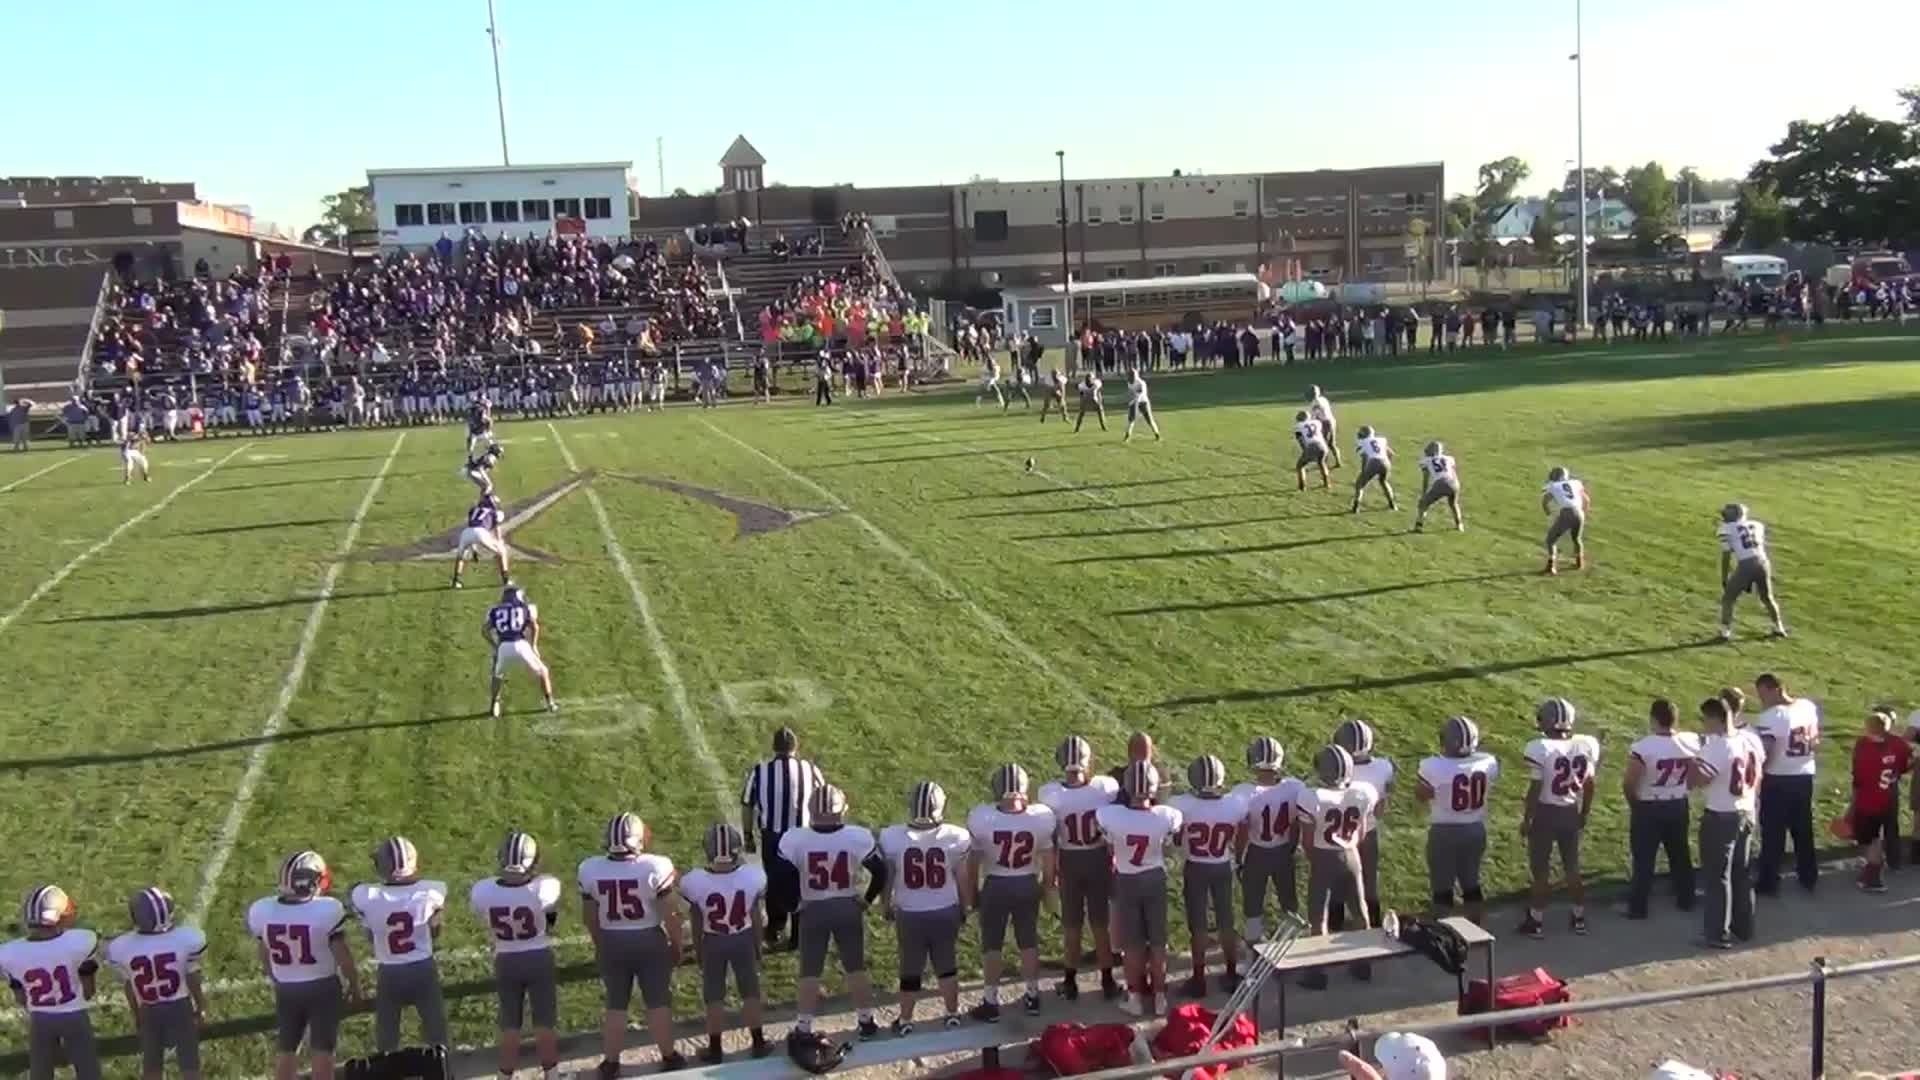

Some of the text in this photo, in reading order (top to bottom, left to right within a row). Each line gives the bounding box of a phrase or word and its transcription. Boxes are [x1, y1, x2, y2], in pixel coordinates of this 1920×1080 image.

[495, 607, 525, 632] 28
[1452, 771, 1487, 811] 60
[1064, 808, 1101, 846] 10
[1187, 822, 1234, 858] 20
[1261, 801, 1292, 842] 14
[1323, 806, 1361, 846] 26
[903, 847, 946, 889] 66
[993, 830, 1036, 867] 72
[1127, 834, 1150, 866] 7
[807, 850, 850, 891] 54
[597, 878, 645, 921] 75
[706, 890, 747, 934] 24
[386, 911, 419, 954] 2
[489, 905, 537, 941] 53
[266, 923, 317, 965] 57
[24, 963, 77, 1007] 21
[130, 951, 181, 1003] 25
